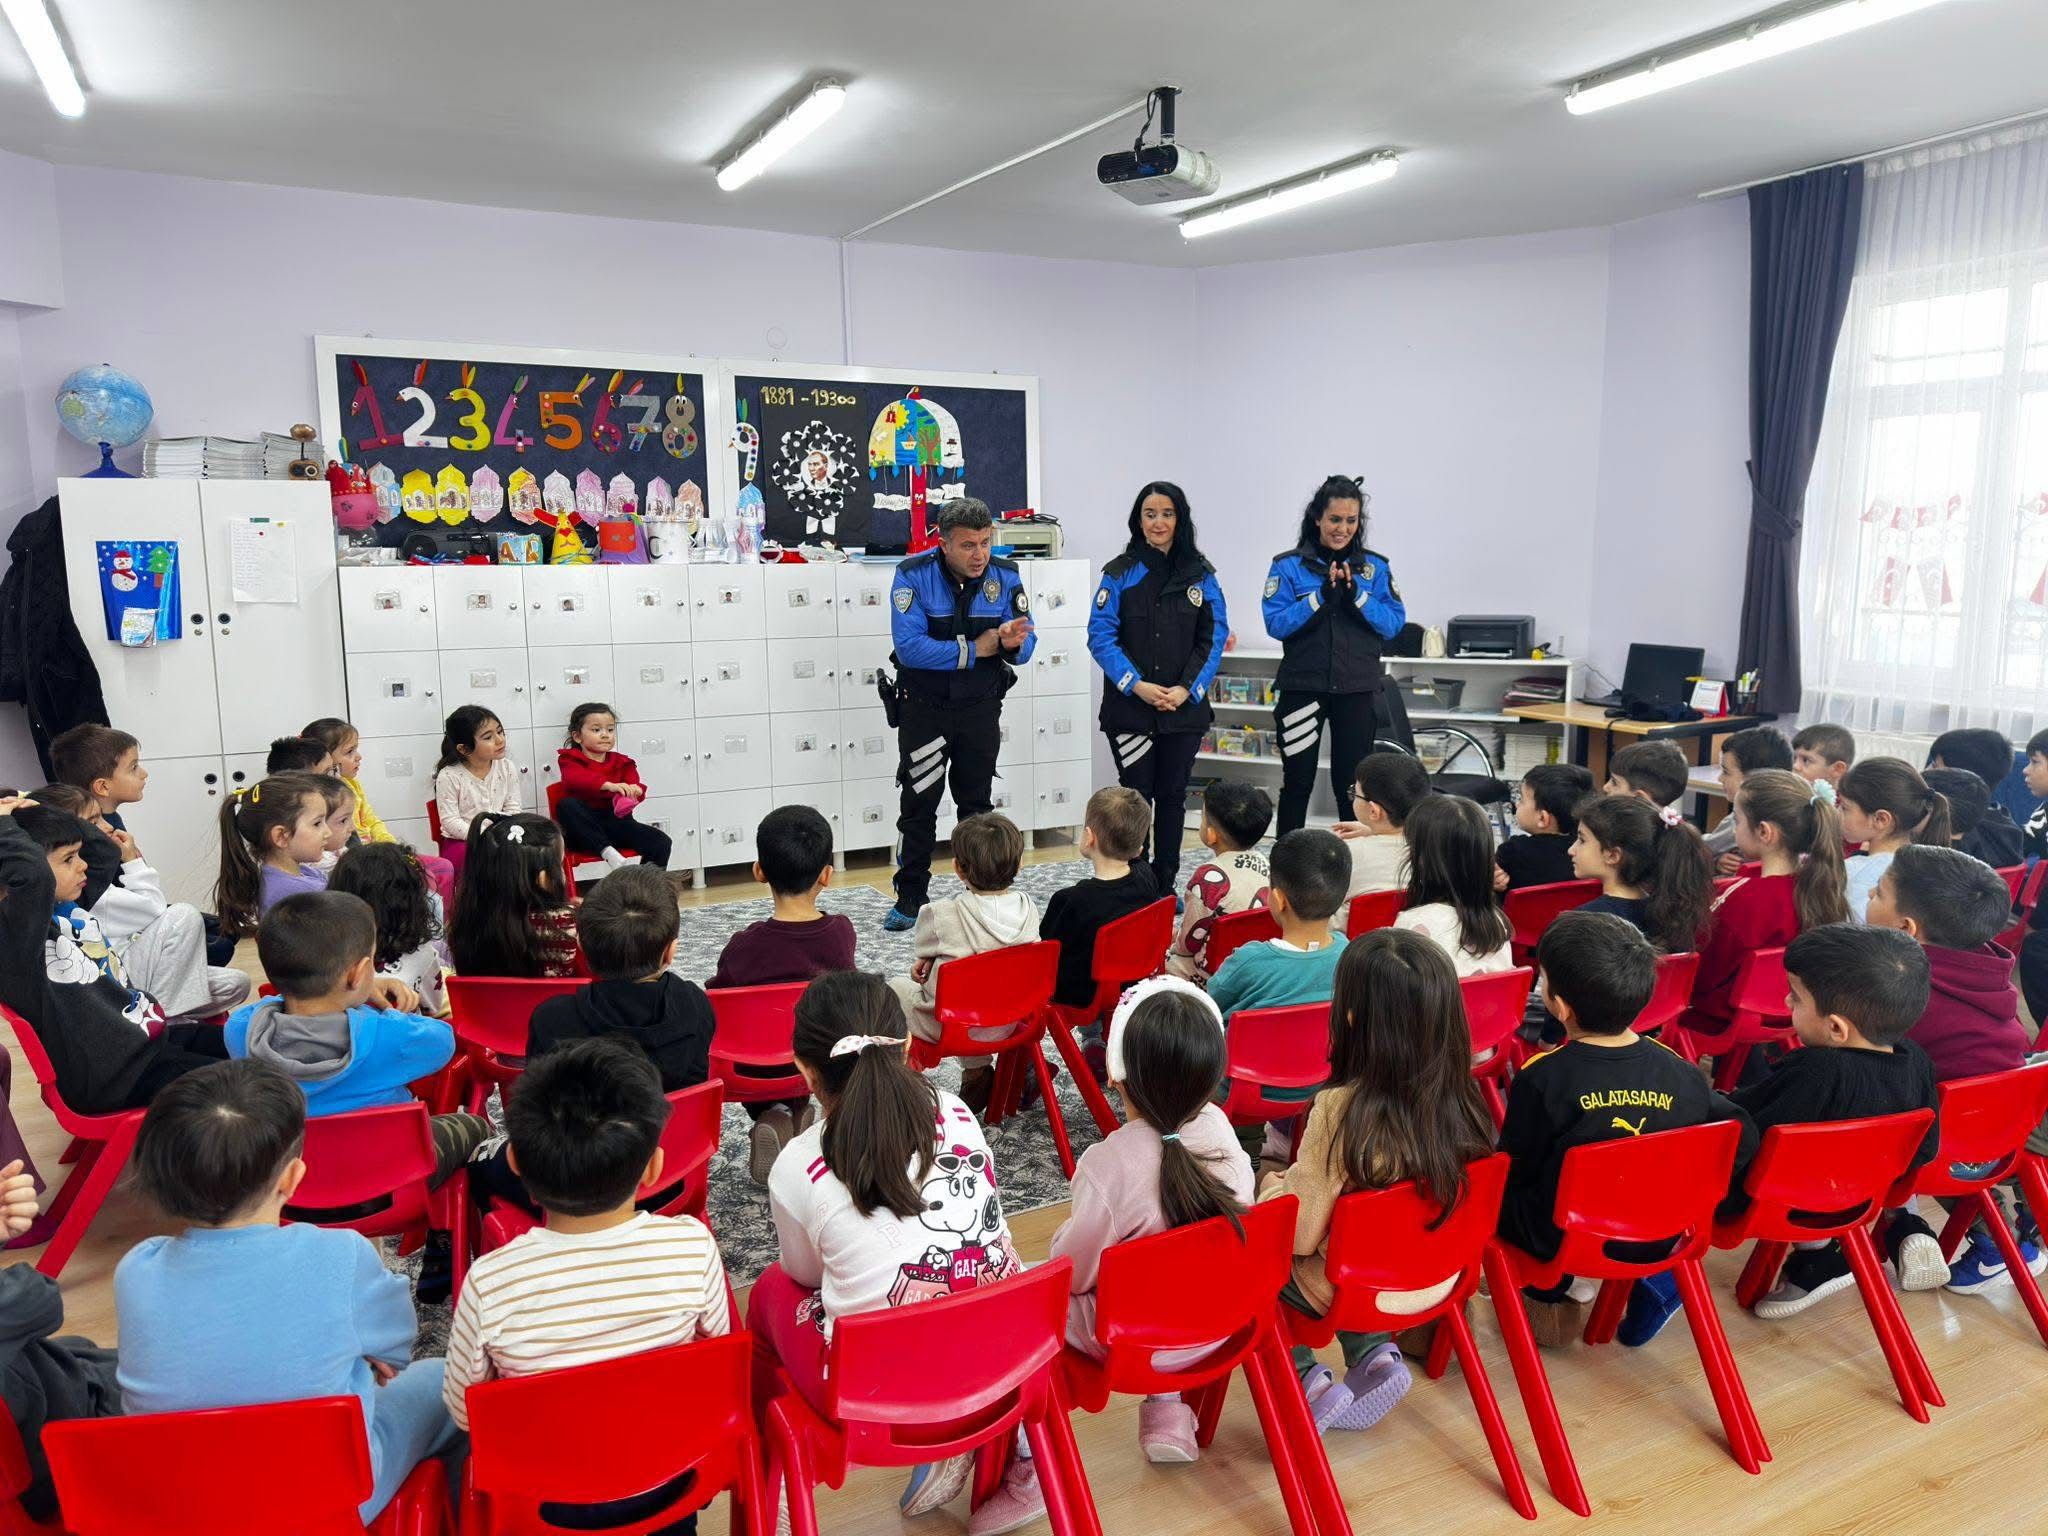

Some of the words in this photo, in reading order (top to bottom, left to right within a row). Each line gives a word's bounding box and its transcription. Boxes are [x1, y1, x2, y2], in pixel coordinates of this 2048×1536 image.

[761, 386, 795, 405] 1881
[352, 385, 404, 450] 1
[396, 386, 448, 448] 2
[446, 387, 491, 450] 3
[494, 393, 534, 453] 4
[539, 391, 583, 450] 5
[591, 392, 623, 453] 6
[619, 394, 663, 452] 7
[662, 394, 698, 459] 8
[729, 422, 759, 481] 9
[1234, 858, 1271, 880] PIDER
[1579, 1089, 1674, 1112] GALATASARAY
